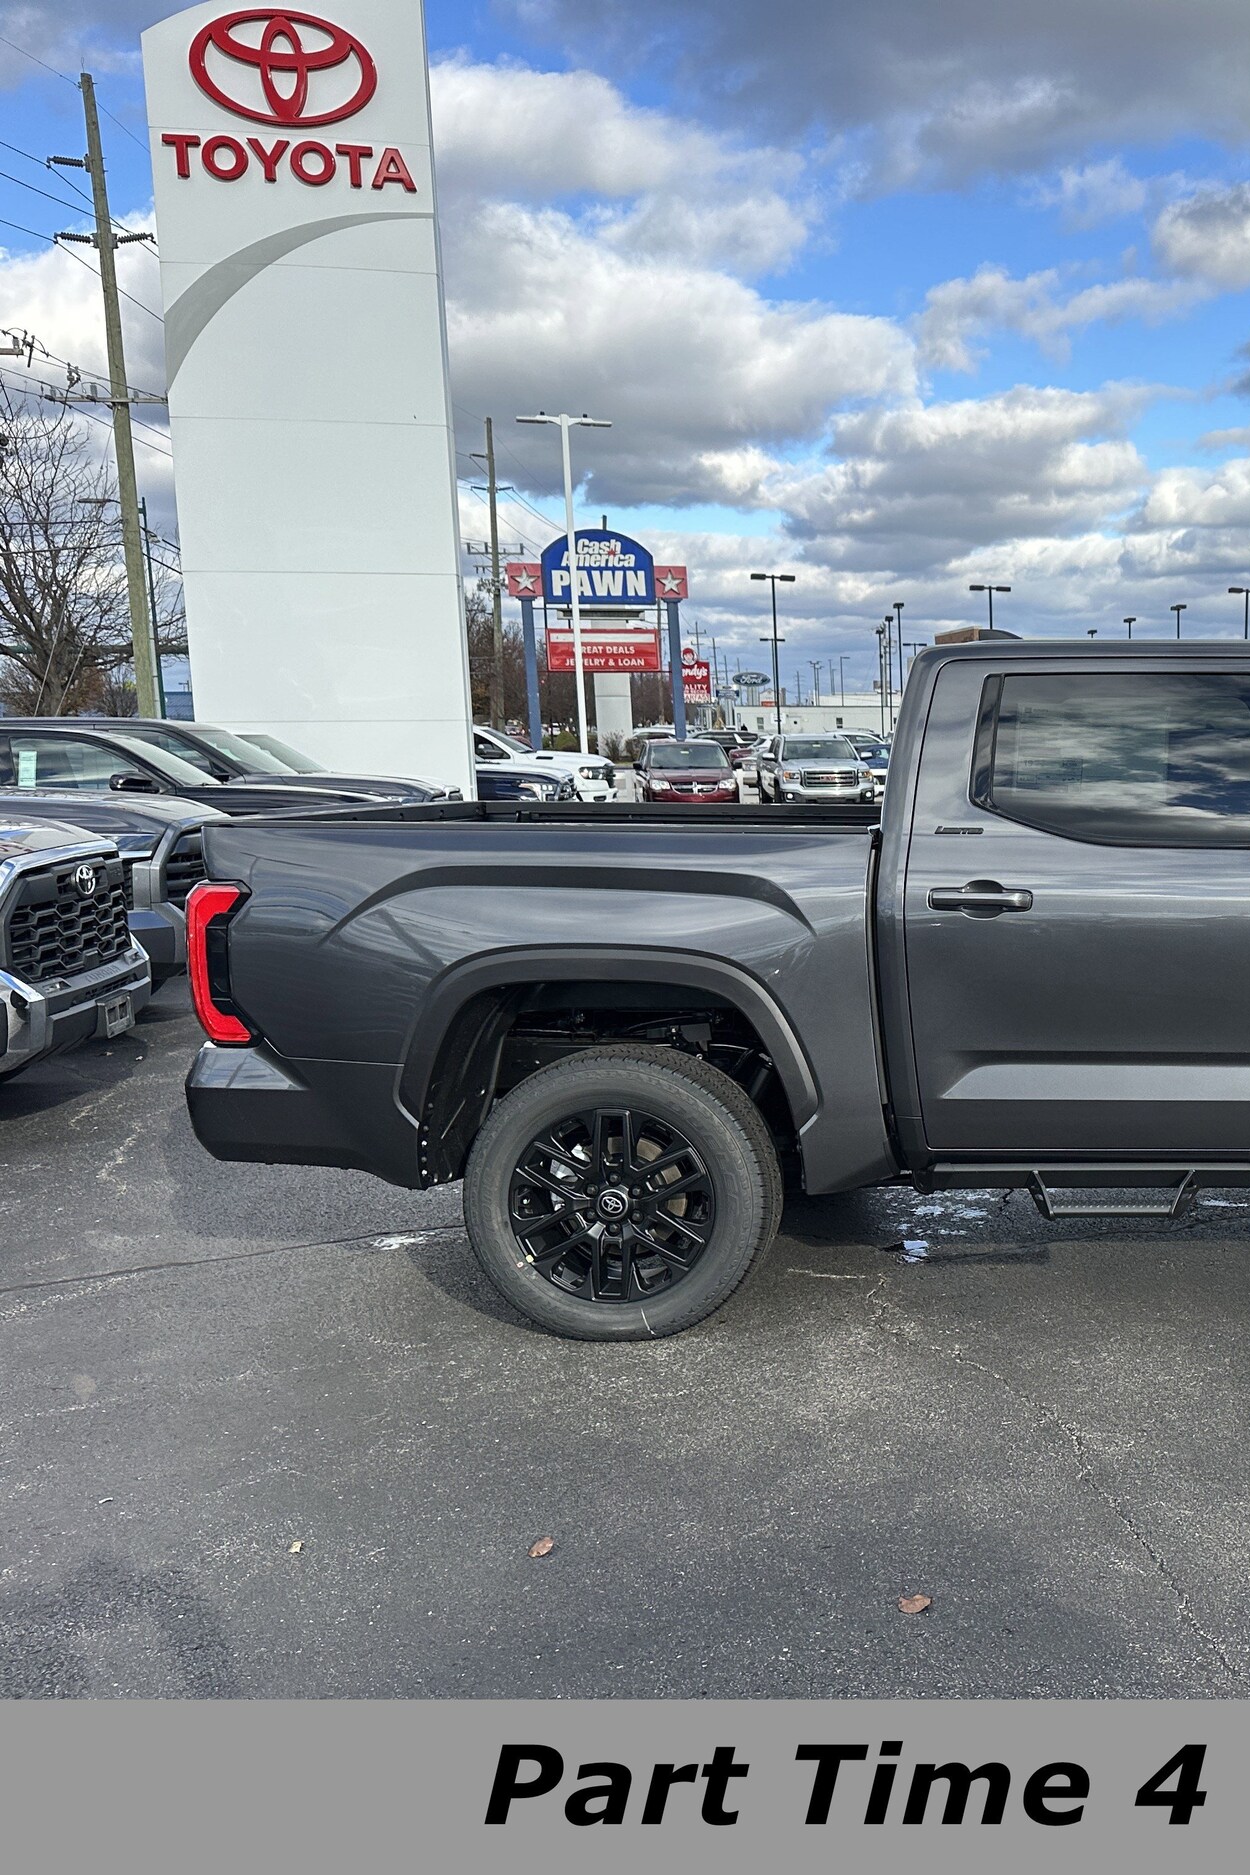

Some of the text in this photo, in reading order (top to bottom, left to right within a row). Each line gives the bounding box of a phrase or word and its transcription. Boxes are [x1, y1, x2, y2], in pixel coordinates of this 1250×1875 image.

[161, 133, 417, 193] TOYOTA
[576, 538, 621, 555] Cash
[560, 551, 635, 567] America
[551, 569, 647, 596] PAWN
[573, 645, 635, 654] REAT DEALS
[565, 658, 645, 667] JEELRY & LOAN
[681, 664, 708, 679] ndy's
[740, 673, 763, 684] Ford
